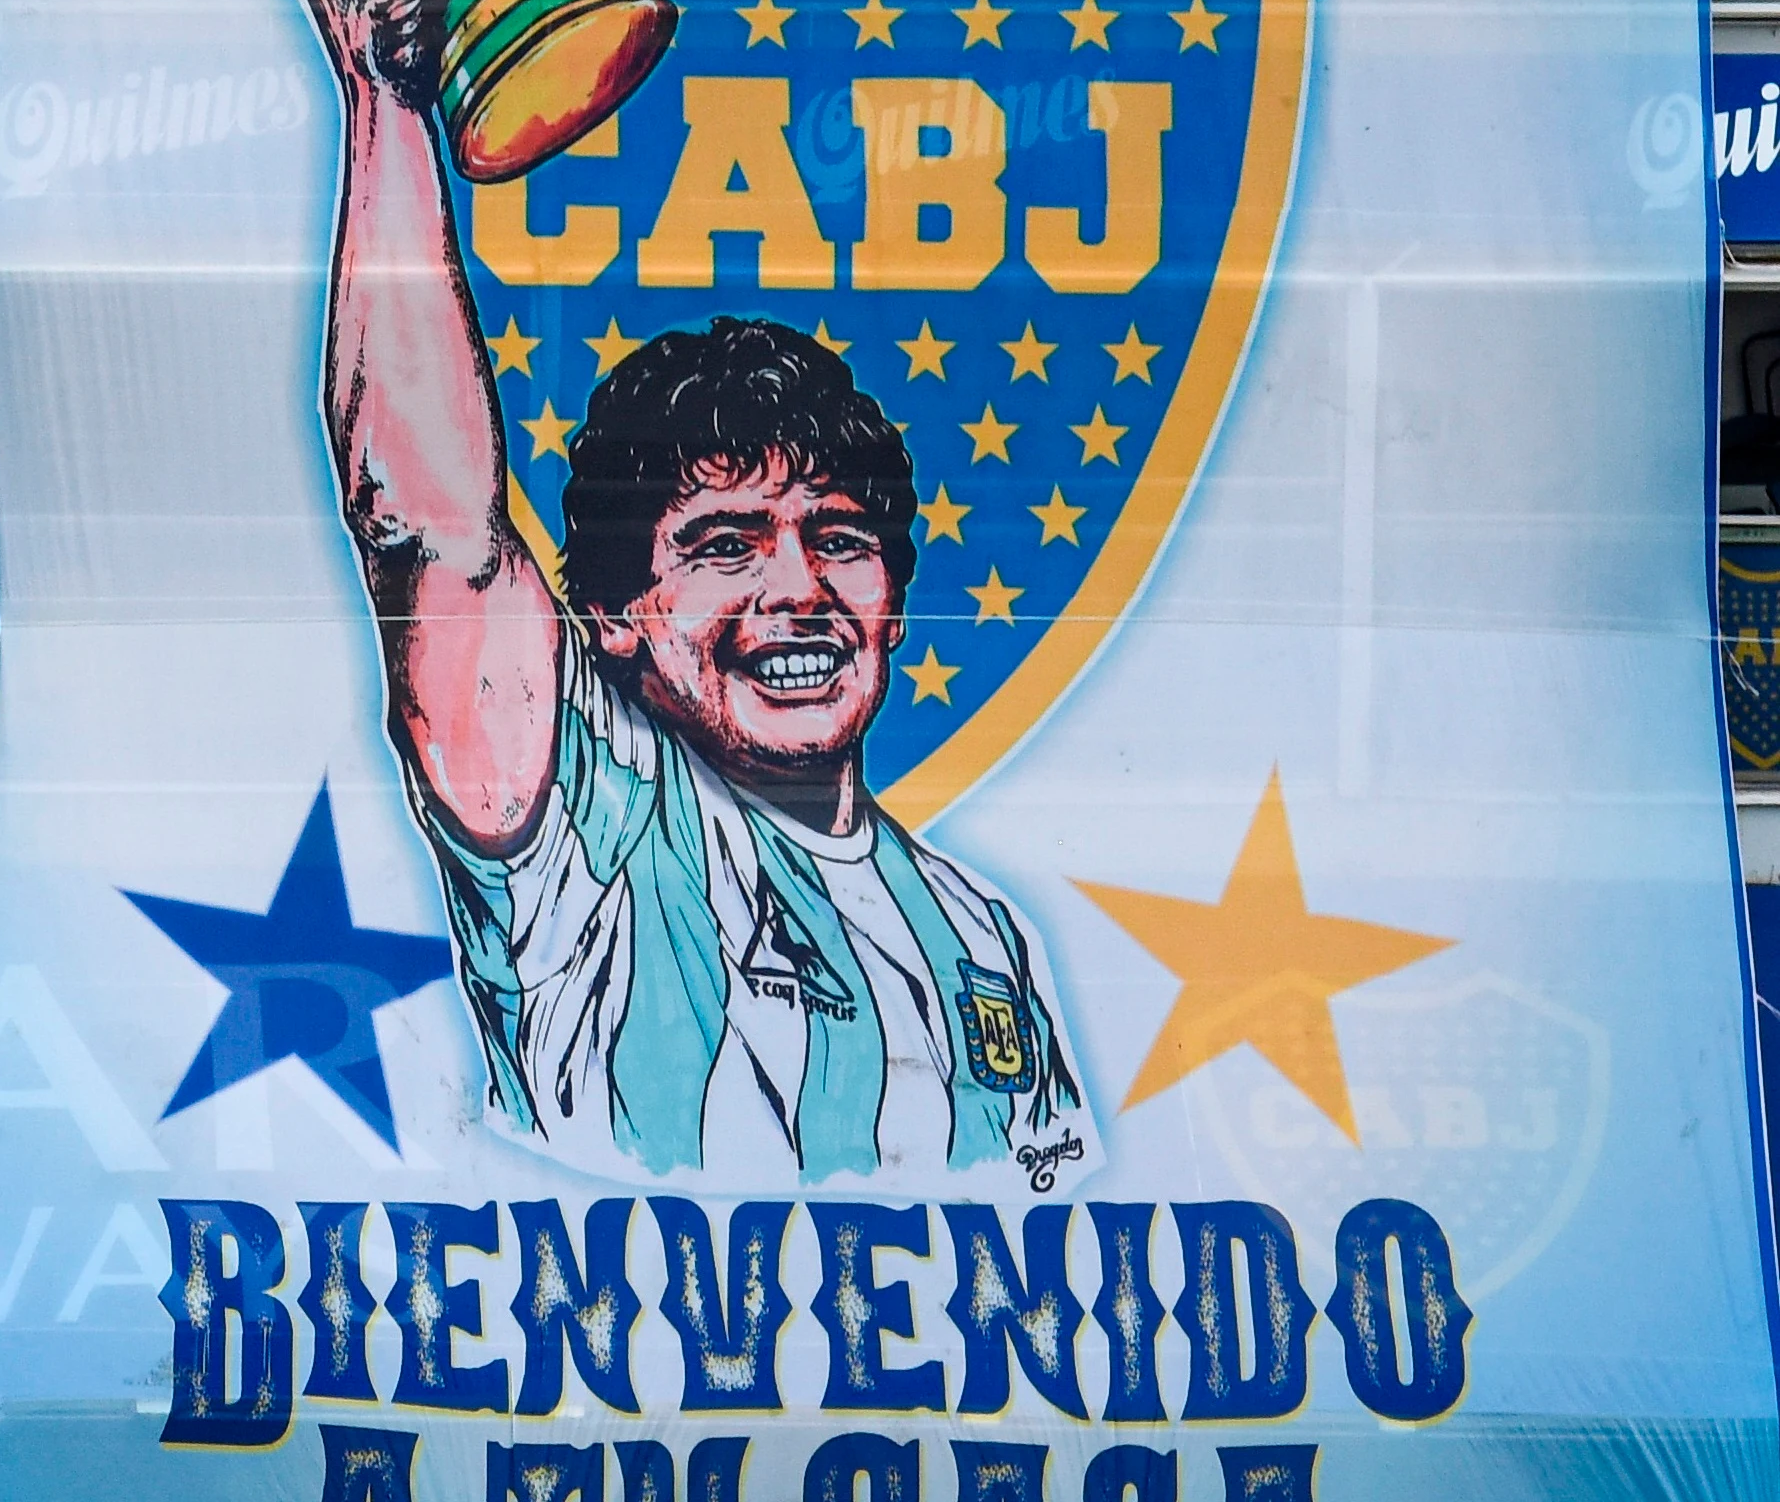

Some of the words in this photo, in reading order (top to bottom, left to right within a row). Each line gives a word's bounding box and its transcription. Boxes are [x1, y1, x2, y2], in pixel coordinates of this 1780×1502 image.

[796, 65, 1121, 204] Quilmes
[762, 981, 795, 1010] coq
[158, 1197, 1476, 1451] BIENVENIDO
